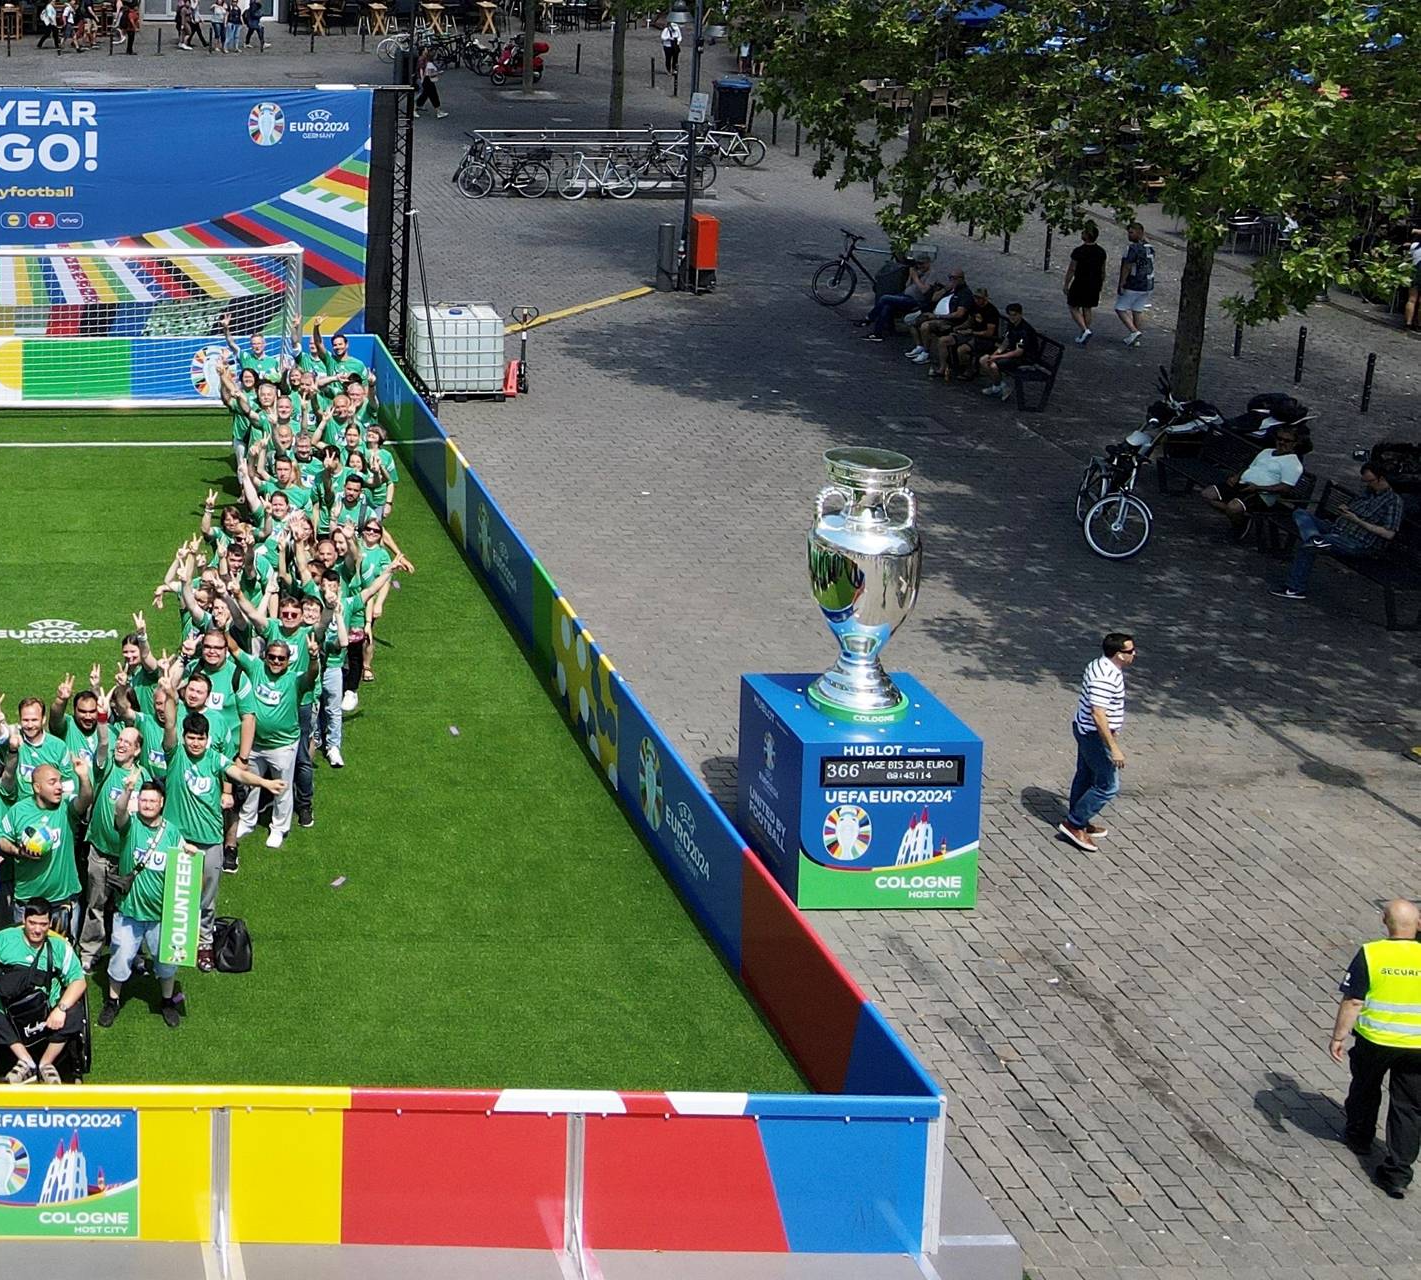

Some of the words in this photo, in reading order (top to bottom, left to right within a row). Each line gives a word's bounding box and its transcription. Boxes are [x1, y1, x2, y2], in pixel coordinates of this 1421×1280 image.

[289, 122, 350, 132] EURO2024
[853, 714, 895, 723] COLOGNE
[843, 745, 903, 756] HUBLOT
[827, 763, 860, 778] 366
[862, 760, 886, 769] TAGE
[887, 760, 904, 769] BIS
[905, 760, 925, 769] ZUR
[926, 760, 953, 769] EURO
[749, 784, 775, 824] UNITED
[775, 816, 786, 838] BY
[749, 799, 786, 853] FOOTBALL
[665, 804, 710, 881] EURO2024
[875, 875, 962, 888] COLOGNE
[908, 890, 936, 898] HOST
[937, 890, 961, 898] CITY
[1380, 967, 1421, 977] SECURI
[39, 1212, 129, 1224] COLOGNE
[74, 1226, 100, 1234] HOST
[103, 1226, 128, 1234] CITY
